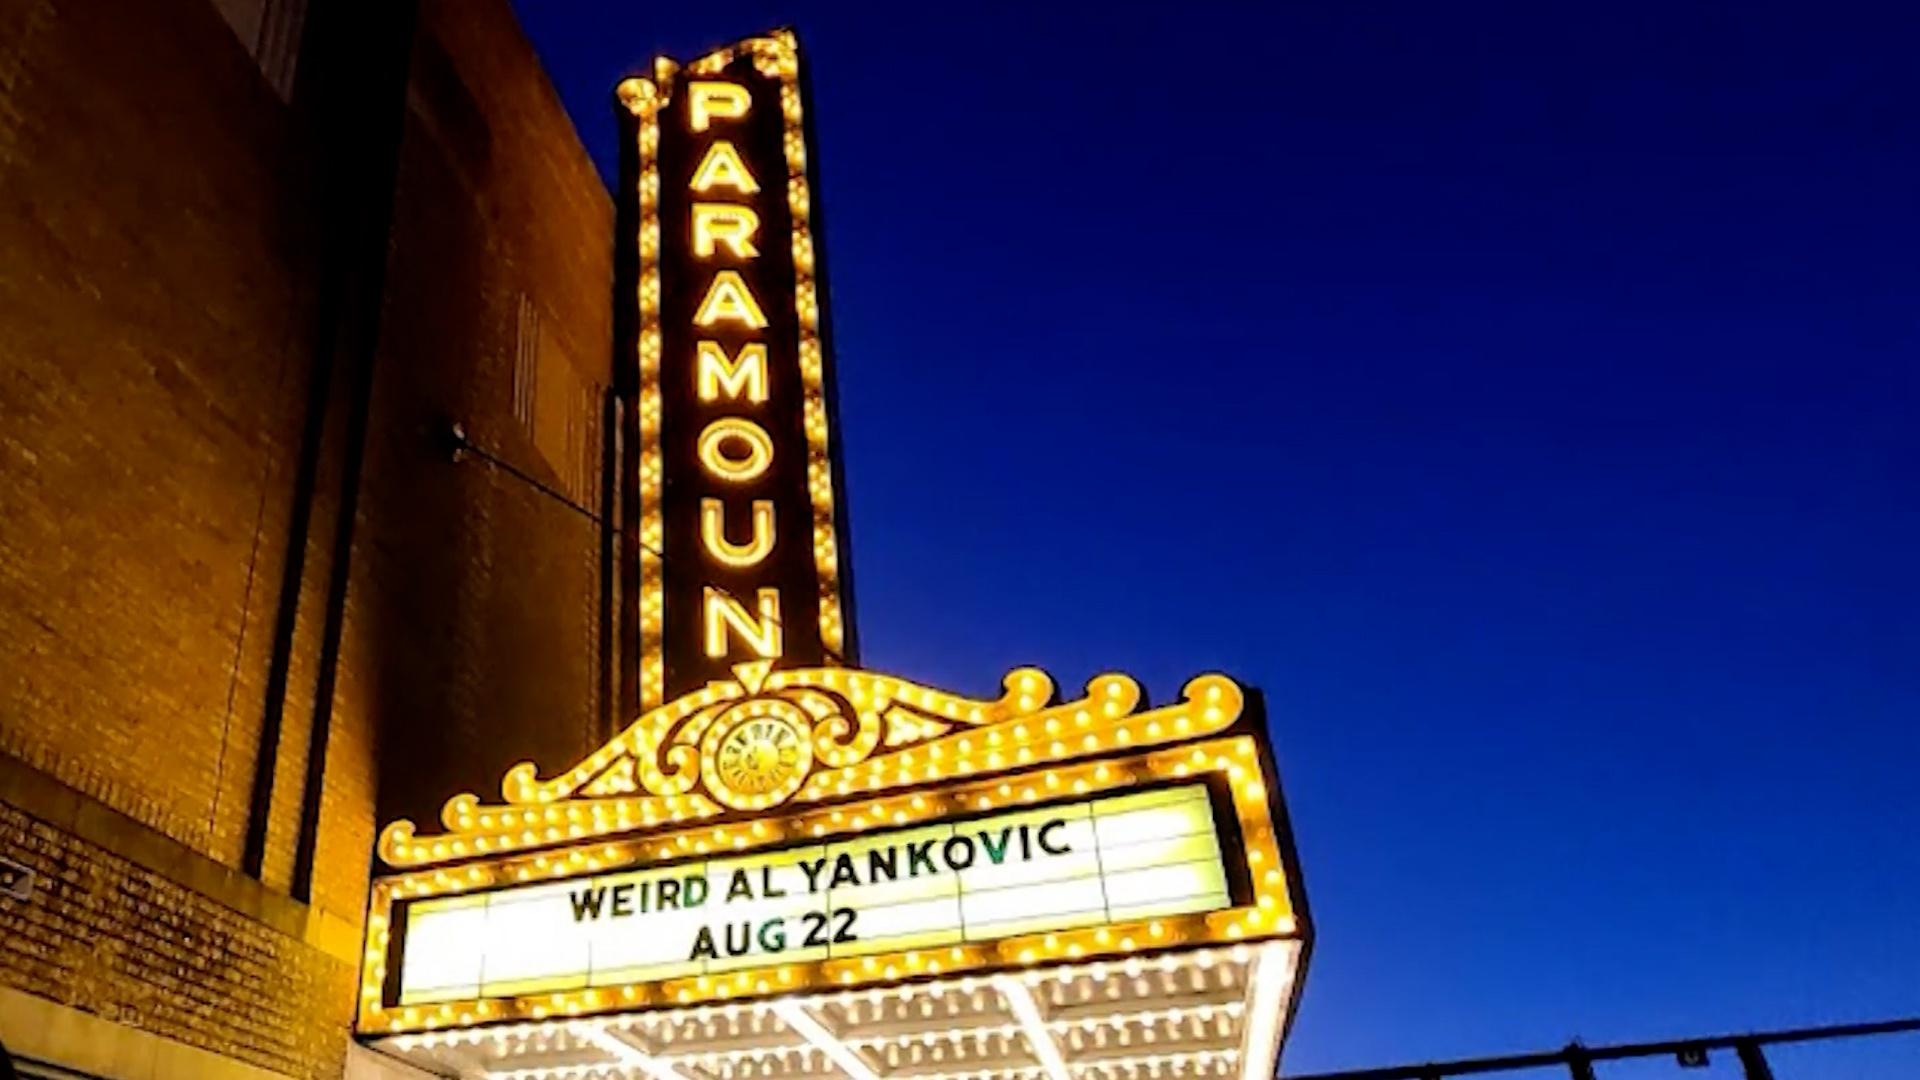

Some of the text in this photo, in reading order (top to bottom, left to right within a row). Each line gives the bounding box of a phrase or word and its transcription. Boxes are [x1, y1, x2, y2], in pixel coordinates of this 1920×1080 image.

[688, 80, 783, 662] PARAMOUN
[570, 819, 1072, 922] WEIRD AL YANKOVIC
[689, 907, 858, 961] AUG 22
